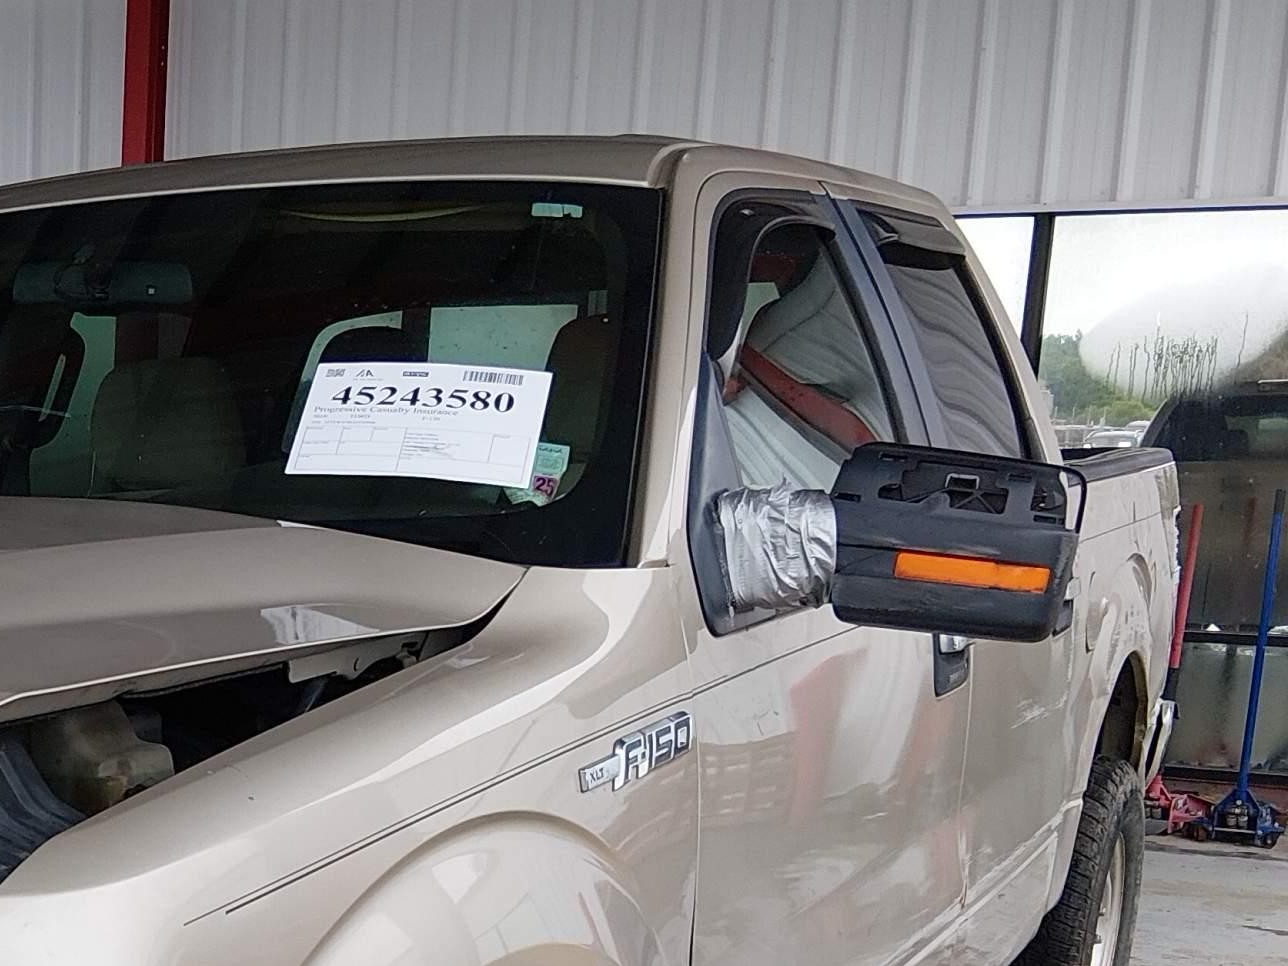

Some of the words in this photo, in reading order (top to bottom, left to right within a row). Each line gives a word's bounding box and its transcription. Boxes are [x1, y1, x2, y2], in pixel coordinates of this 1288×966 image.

[331, 385, 515, 413] 45243580
[313, 405, 366, 414] Progressive
[369, 406, 410, 415] Casualty
[412, 407, 459, 416] Insurance
[535, 477, 554, 498] 25
[589, 766, 604, 785] XLT
